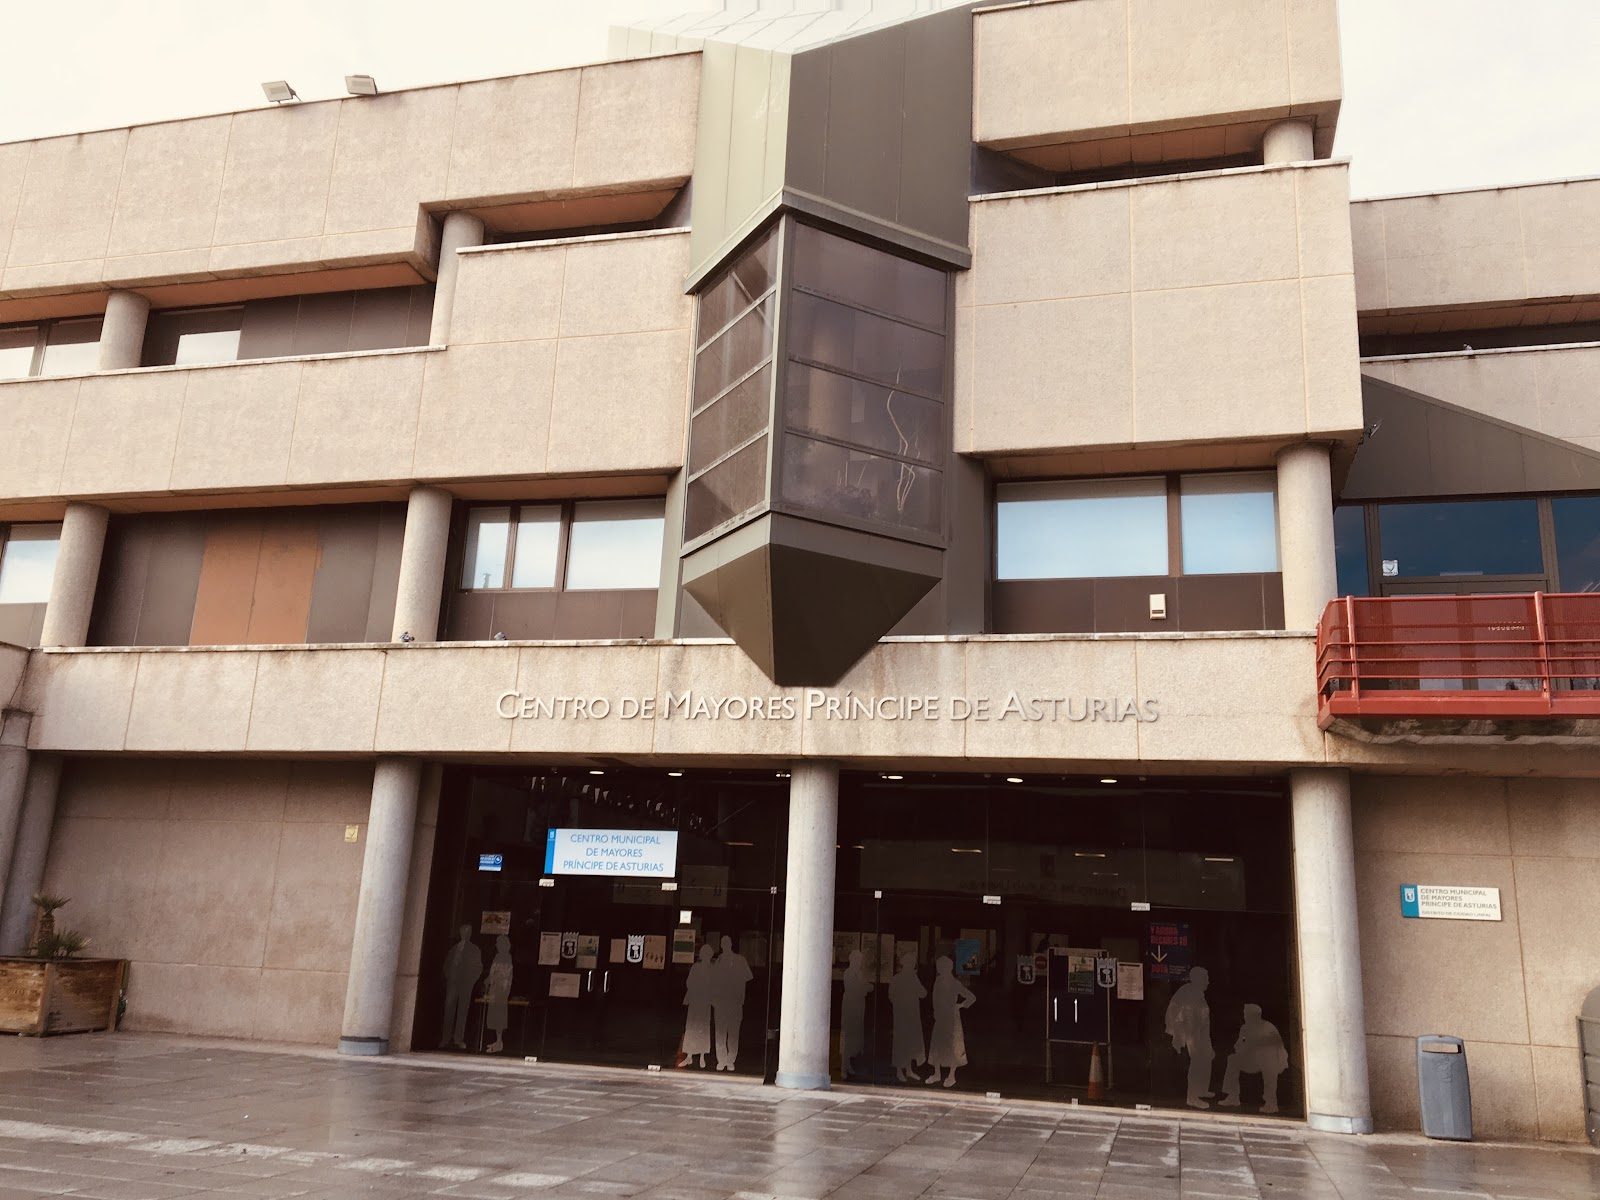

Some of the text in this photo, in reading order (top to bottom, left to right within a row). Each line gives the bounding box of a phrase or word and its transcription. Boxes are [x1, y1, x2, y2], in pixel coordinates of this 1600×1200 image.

[618, 697, 656, 720] DE
[948, 696, 990, 722] DE
[570, 833, 661, 845] CENTRO MUNICIPAL
[585, 847, 643, 858] DE MAYORES
[605, 862, 618, 871] DE
[619, 862, 664, 872] ASTURIAS
